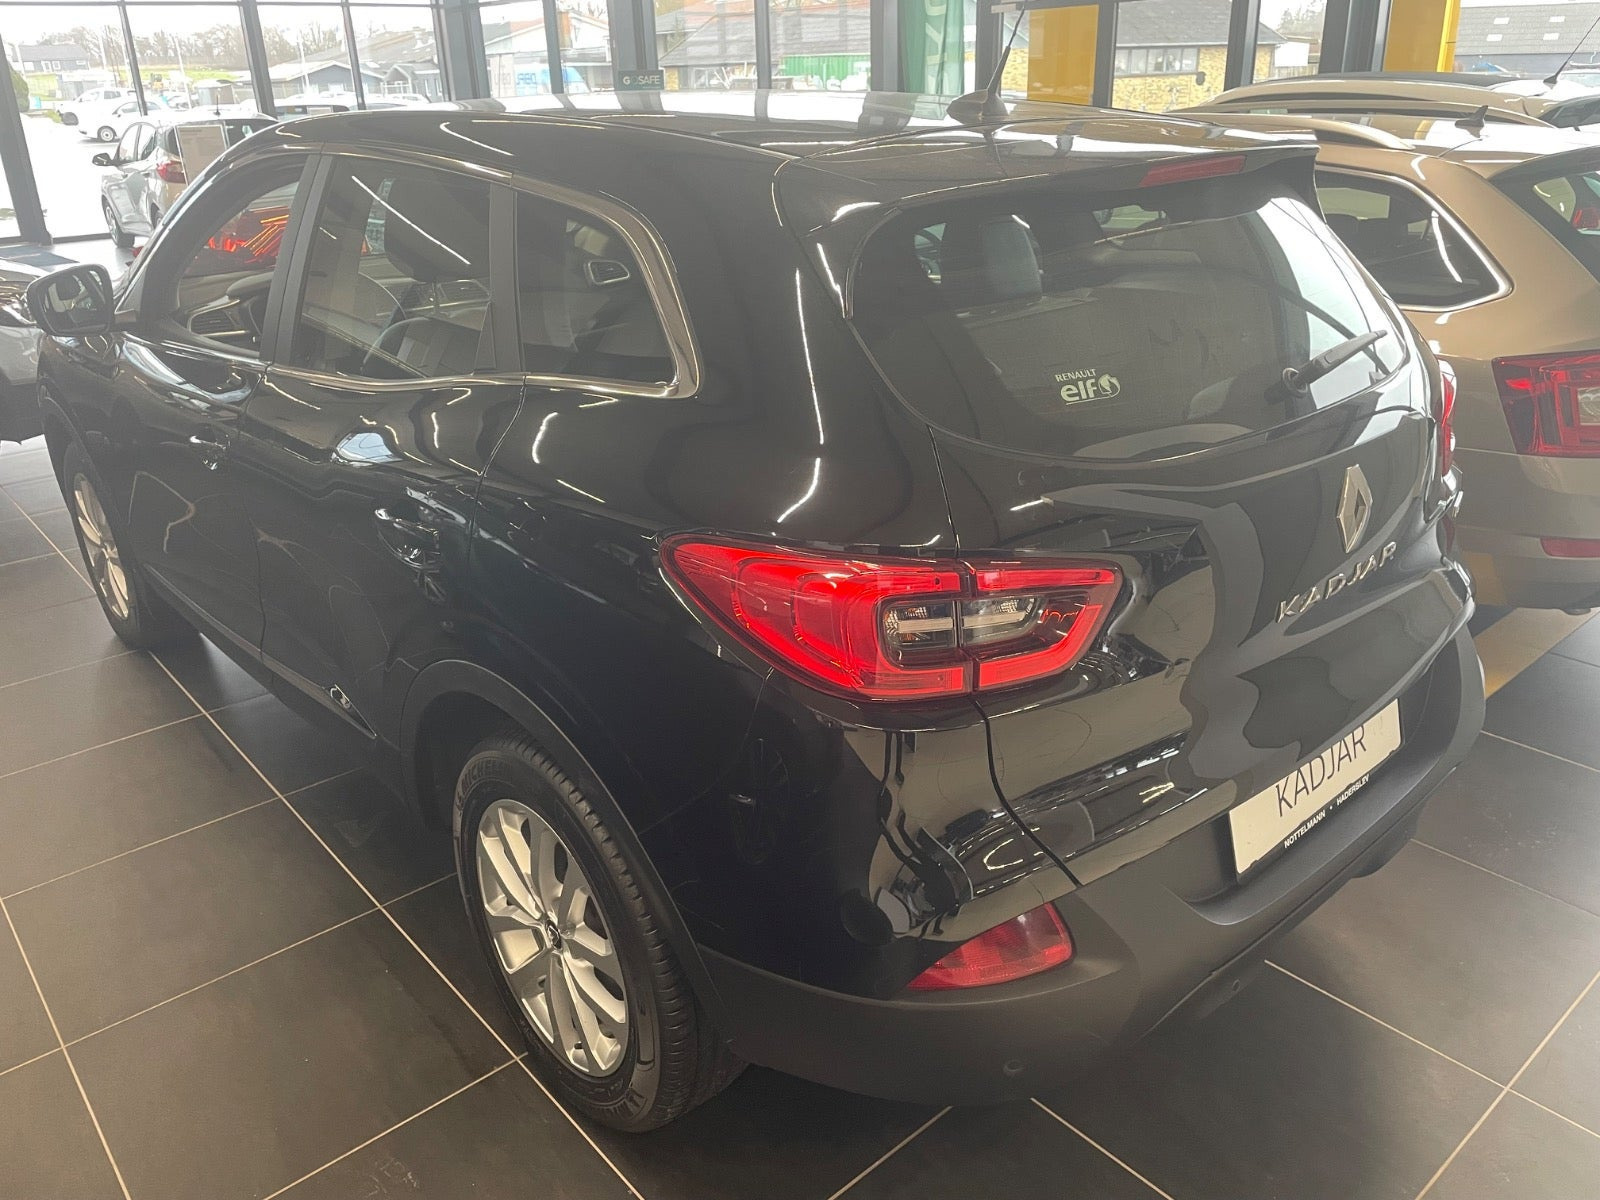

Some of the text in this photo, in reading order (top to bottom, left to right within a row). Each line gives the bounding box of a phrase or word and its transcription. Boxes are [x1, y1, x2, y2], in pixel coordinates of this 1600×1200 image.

[1055, 369, 1096, 382] RENAULT
[1061, 379, 1097, 401] elf
[1277, 541, 1397, 623] KADJAR
[1276, 724, 1366, 817] KADJAR
[1284, 774, 1370, 848] NOTTELMANN HADERSLEV
